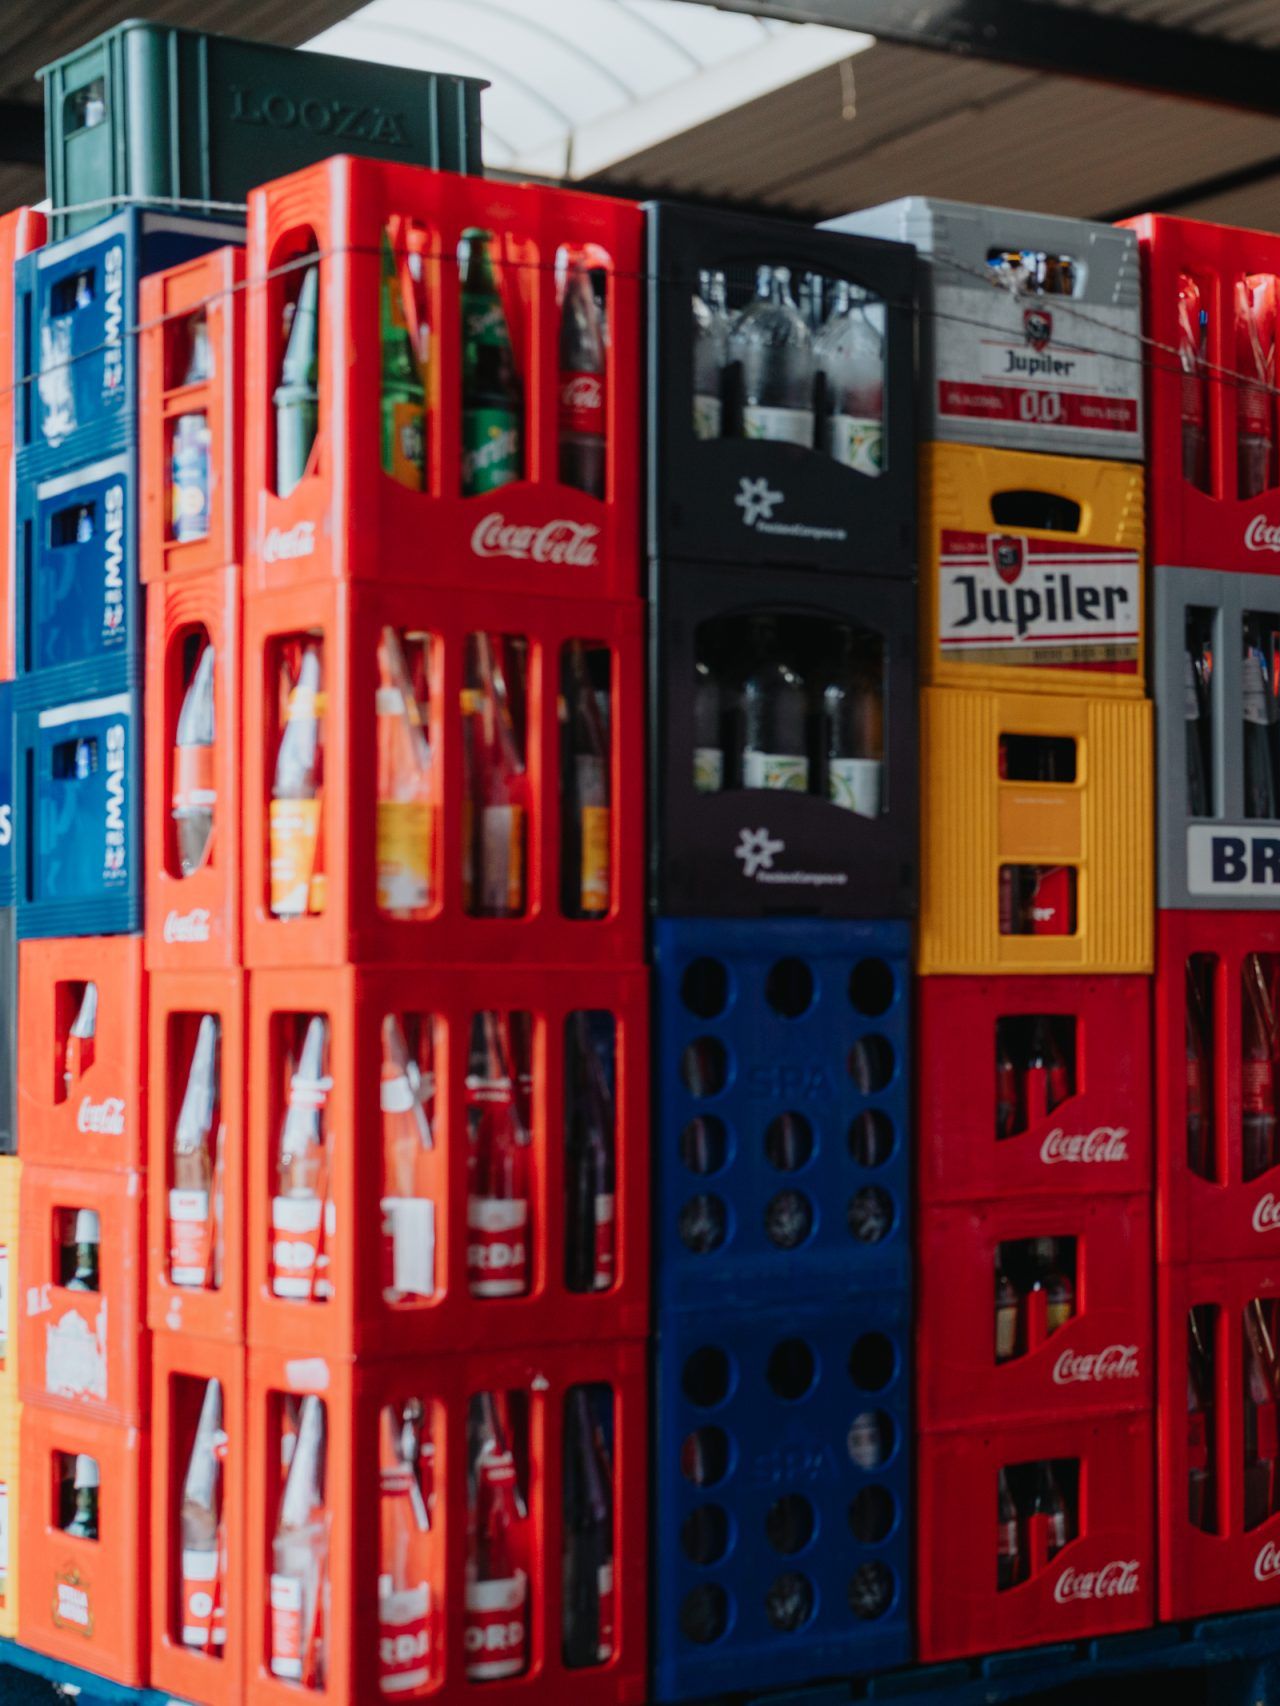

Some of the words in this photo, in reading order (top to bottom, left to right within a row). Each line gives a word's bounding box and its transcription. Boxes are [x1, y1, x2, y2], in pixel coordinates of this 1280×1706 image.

[230, 84, 412, 147] LOOZA
[1003, 350, 1076, 376] Jupiler
[952, 573, 1129, 637] Jupiler
